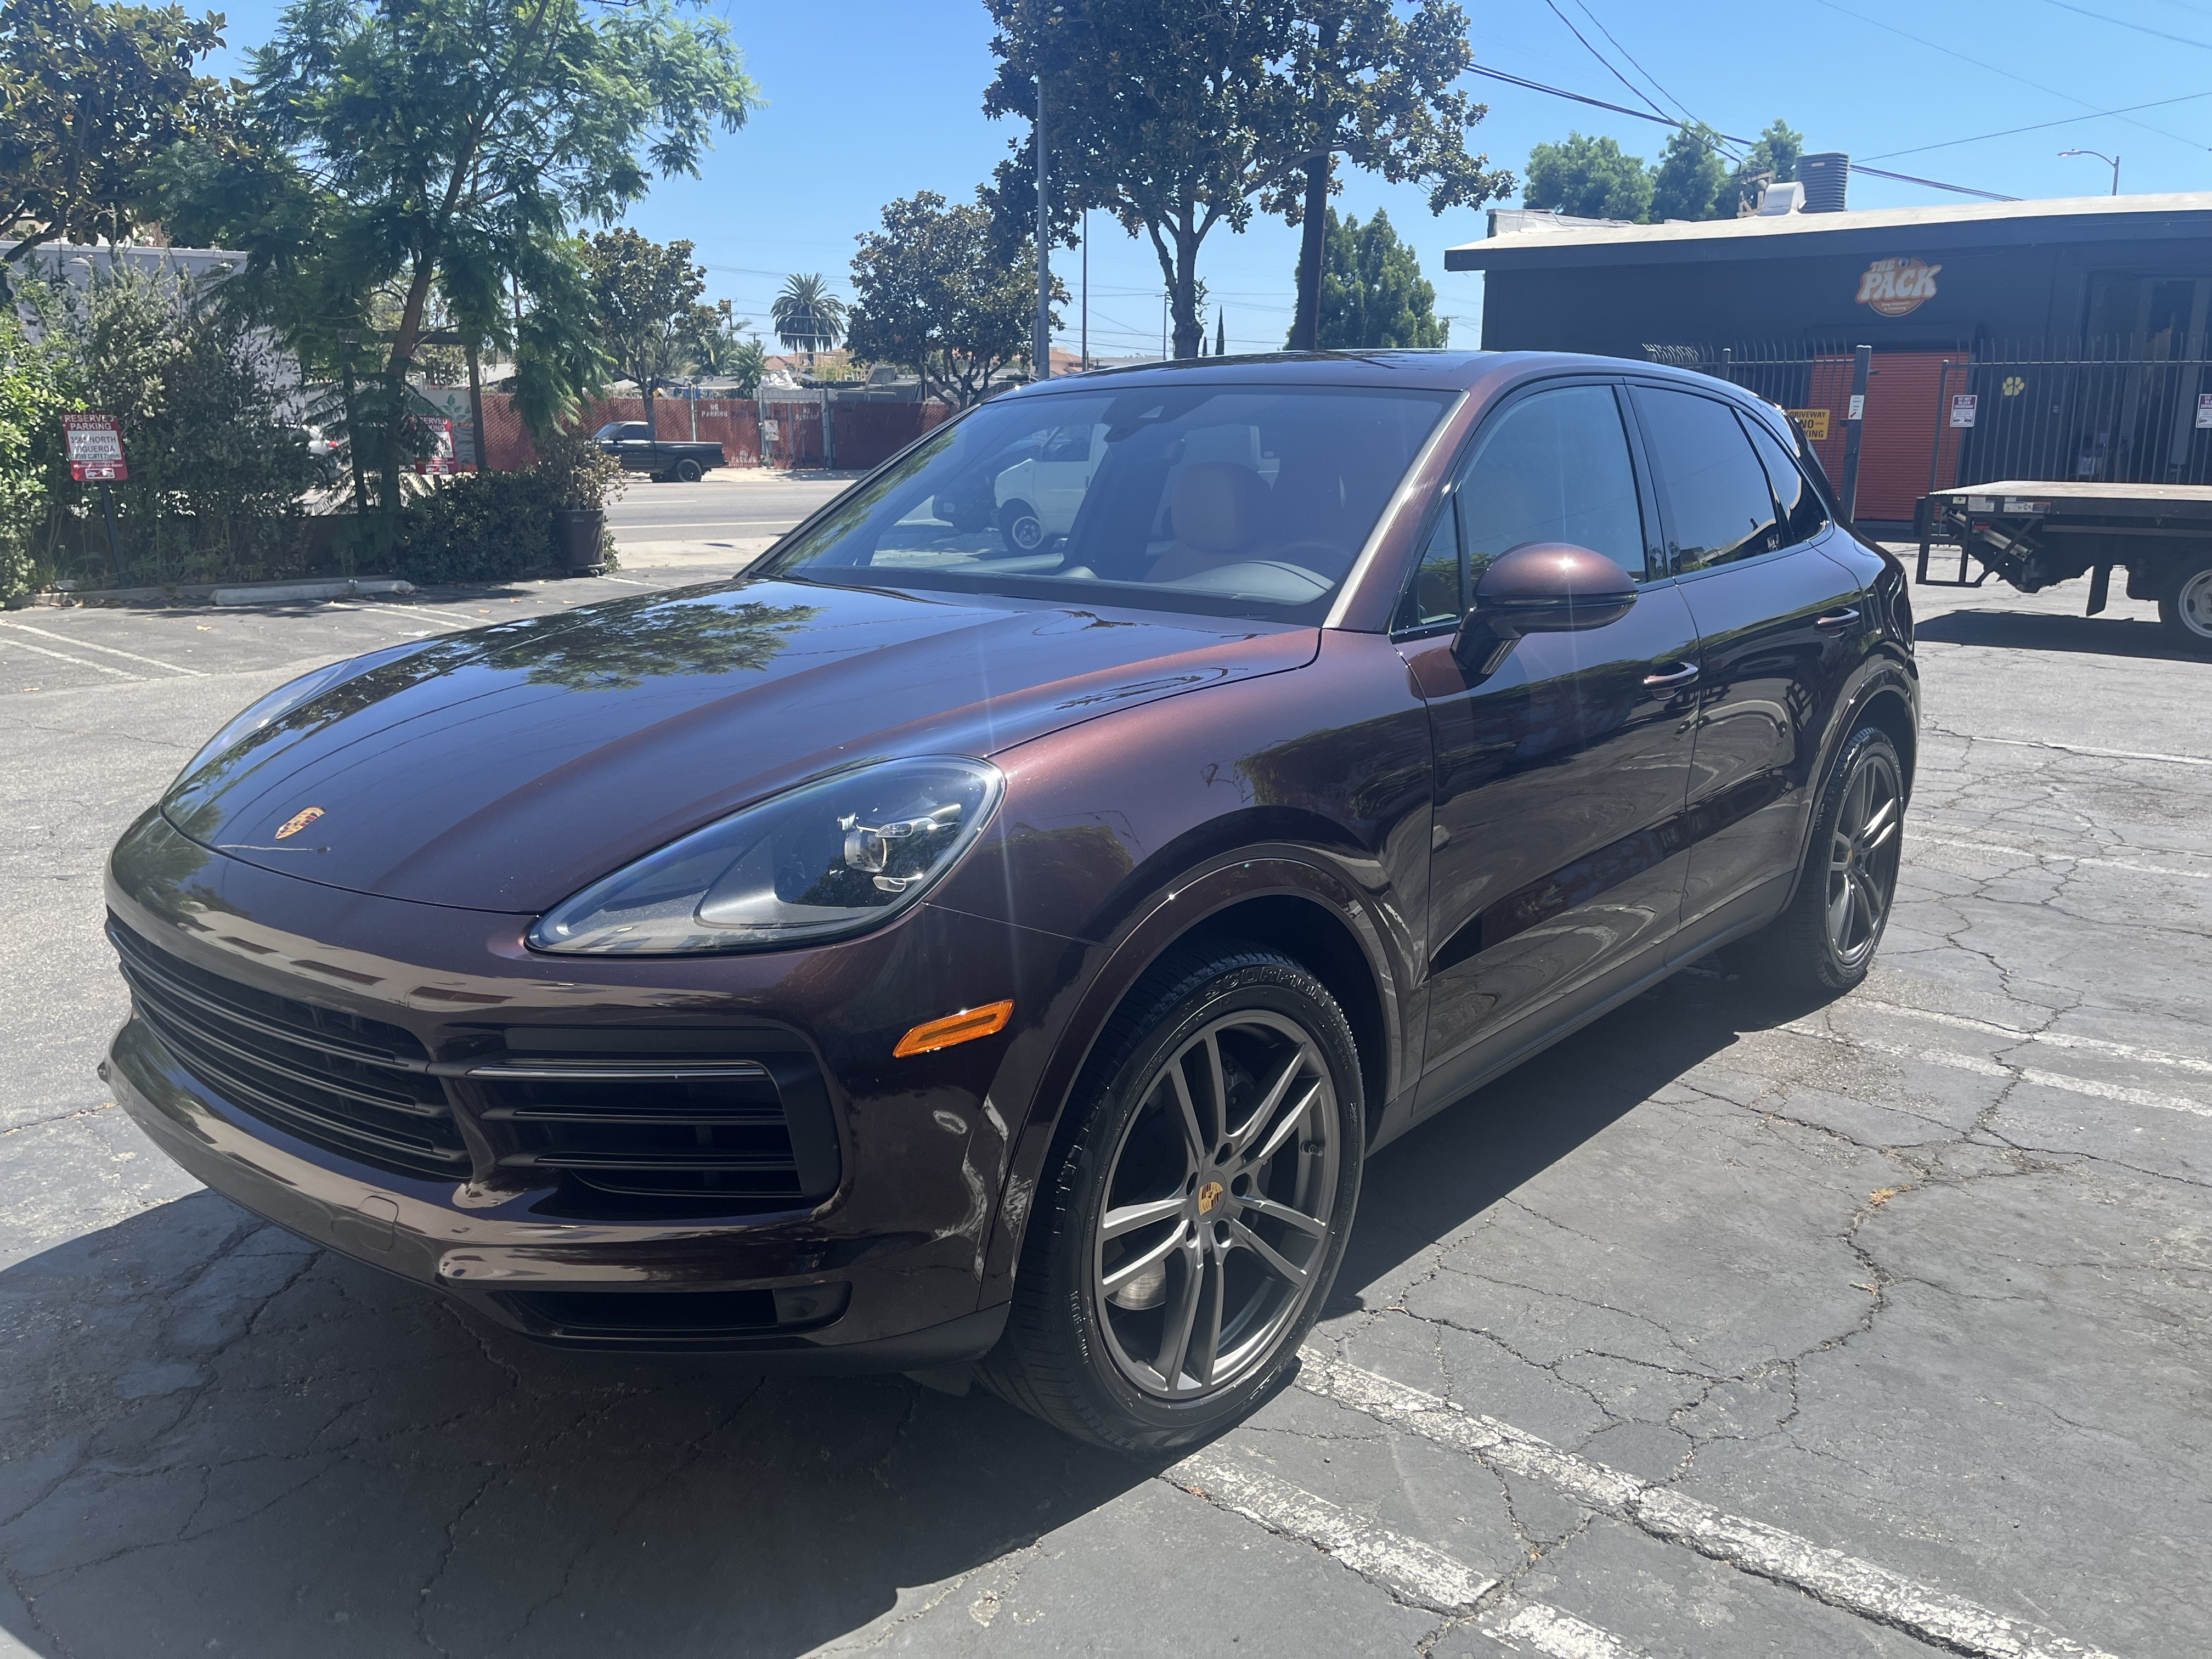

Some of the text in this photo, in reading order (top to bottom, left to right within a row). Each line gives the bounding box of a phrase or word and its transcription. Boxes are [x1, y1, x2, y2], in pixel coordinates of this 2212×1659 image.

[1871, 260, 1895, 272] THE
[1860, 264, 1942, 301] PACK
[1800, 419, 1814, 428] NO
[1205, 967, 1328, 1007] SCORPION
